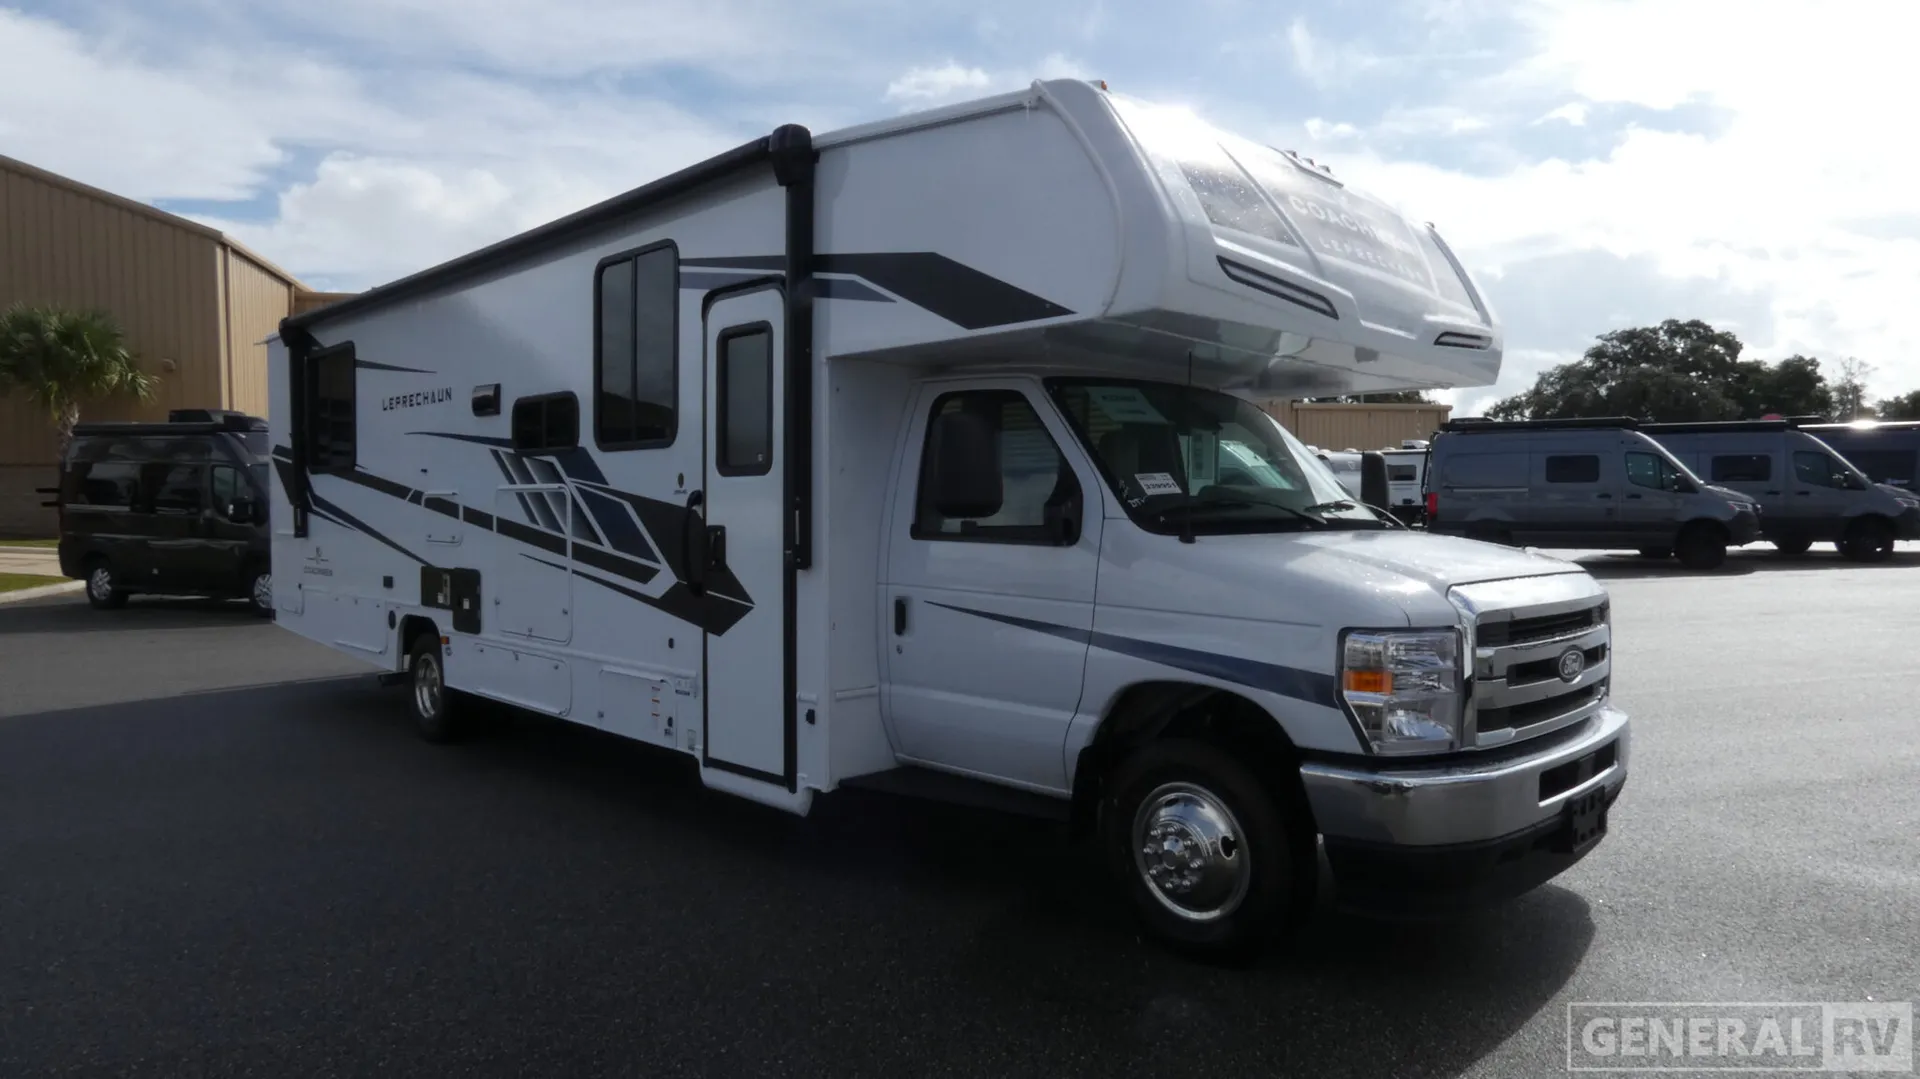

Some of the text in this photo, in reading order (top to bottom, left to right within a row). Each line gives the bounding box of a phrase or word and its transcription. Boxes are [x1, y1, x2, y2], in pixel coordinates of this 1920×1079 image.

[1290, 197, 1418, 255] COACH
[382, 386, 452, 411] LEPRECHAUN
[1562, 653, 1582, 675] Ford
